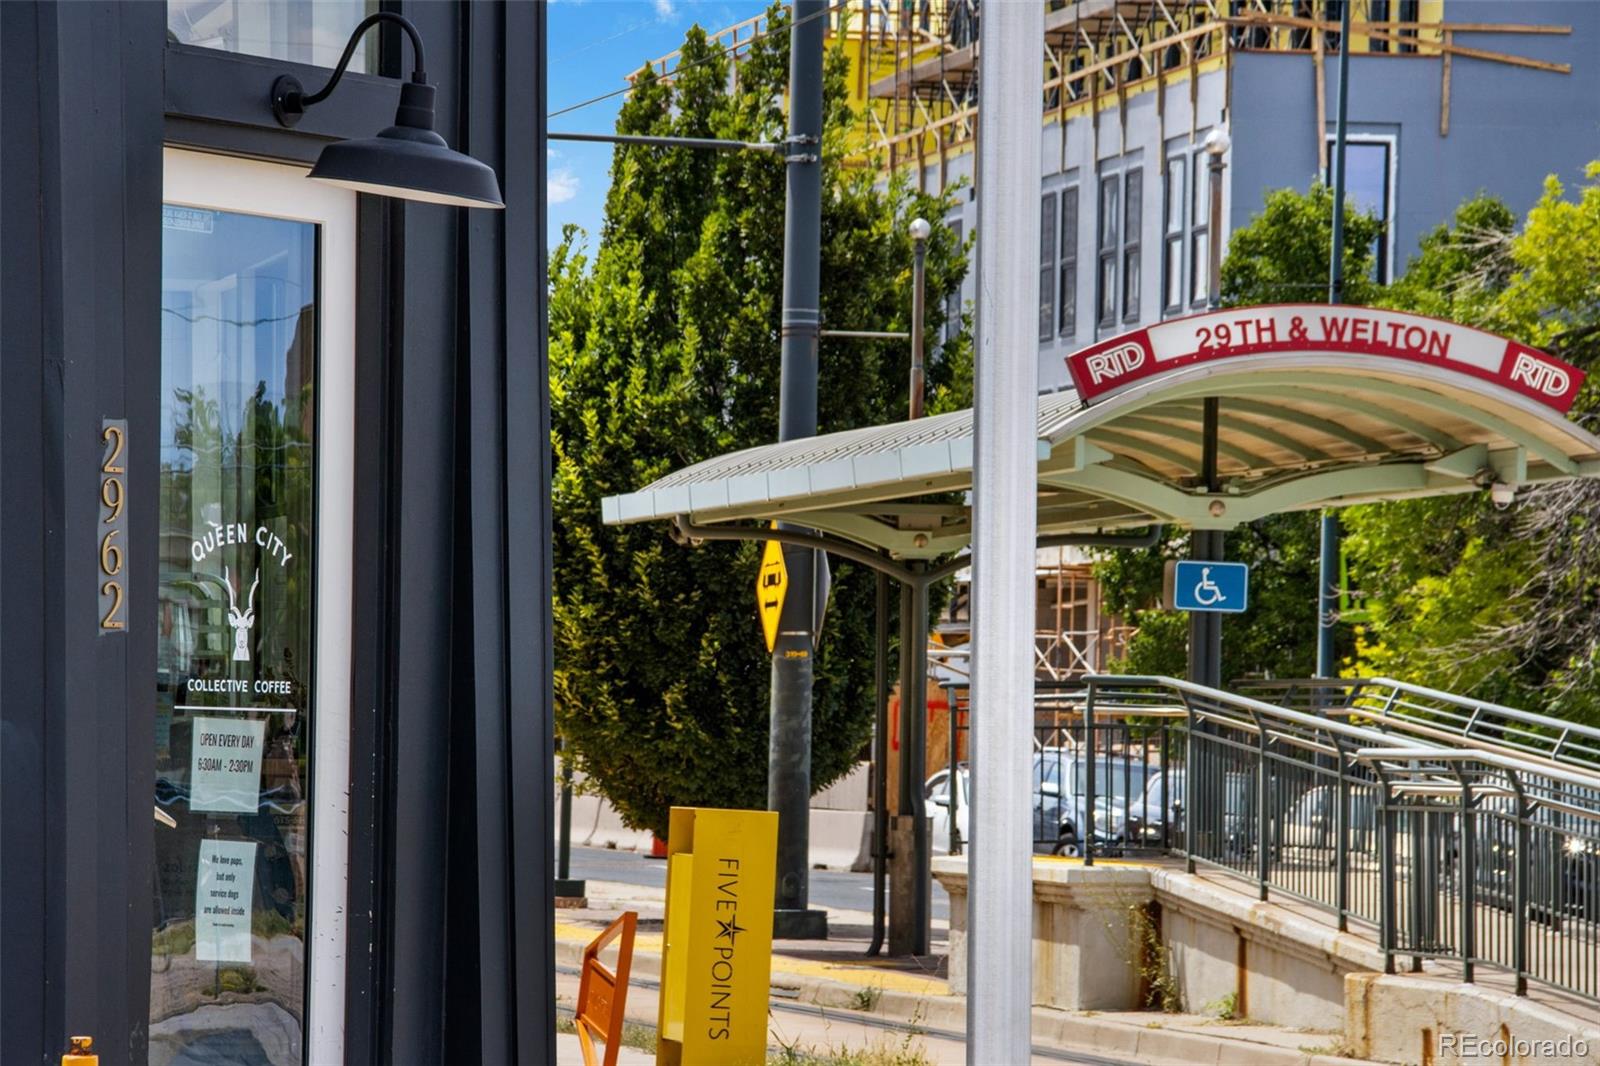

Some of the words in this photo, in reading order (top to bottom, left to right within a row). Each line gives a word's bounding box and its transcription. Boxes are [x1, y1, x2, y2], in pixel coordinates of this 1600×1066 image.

[1195, 317, 1277, 351] 29TH
[1289, 316, 1310, 340] &
[1321, 316, 1452, 358] WELTON
[1086, 341, 1145, 385] RTD
[1510, 352, 1570, 397] RTD
[102, 426, 125, 629] 2962
[191, 522, 247, 562] QUEEN
[256, 526, 293, 567] CITY
[187, 678, 248, 693] COLLECTIVE
[254, 680, 292, 694] COFFEE
[200, 733, 217, 746] OPEN
[219, 734, 241, 748] EVERY
[241, 735, 255, 748] DAY
[228, 759, 253, 773] 2:30PM
[212, 855, 219, 864] We
[220, 855, 230, 865] love
[210, 889, 227, 898] service
[228, 889, 239, 900] dogs
[715, 858, 739, 911] FIVE
[708, 947, 734, 1040] POINTS
